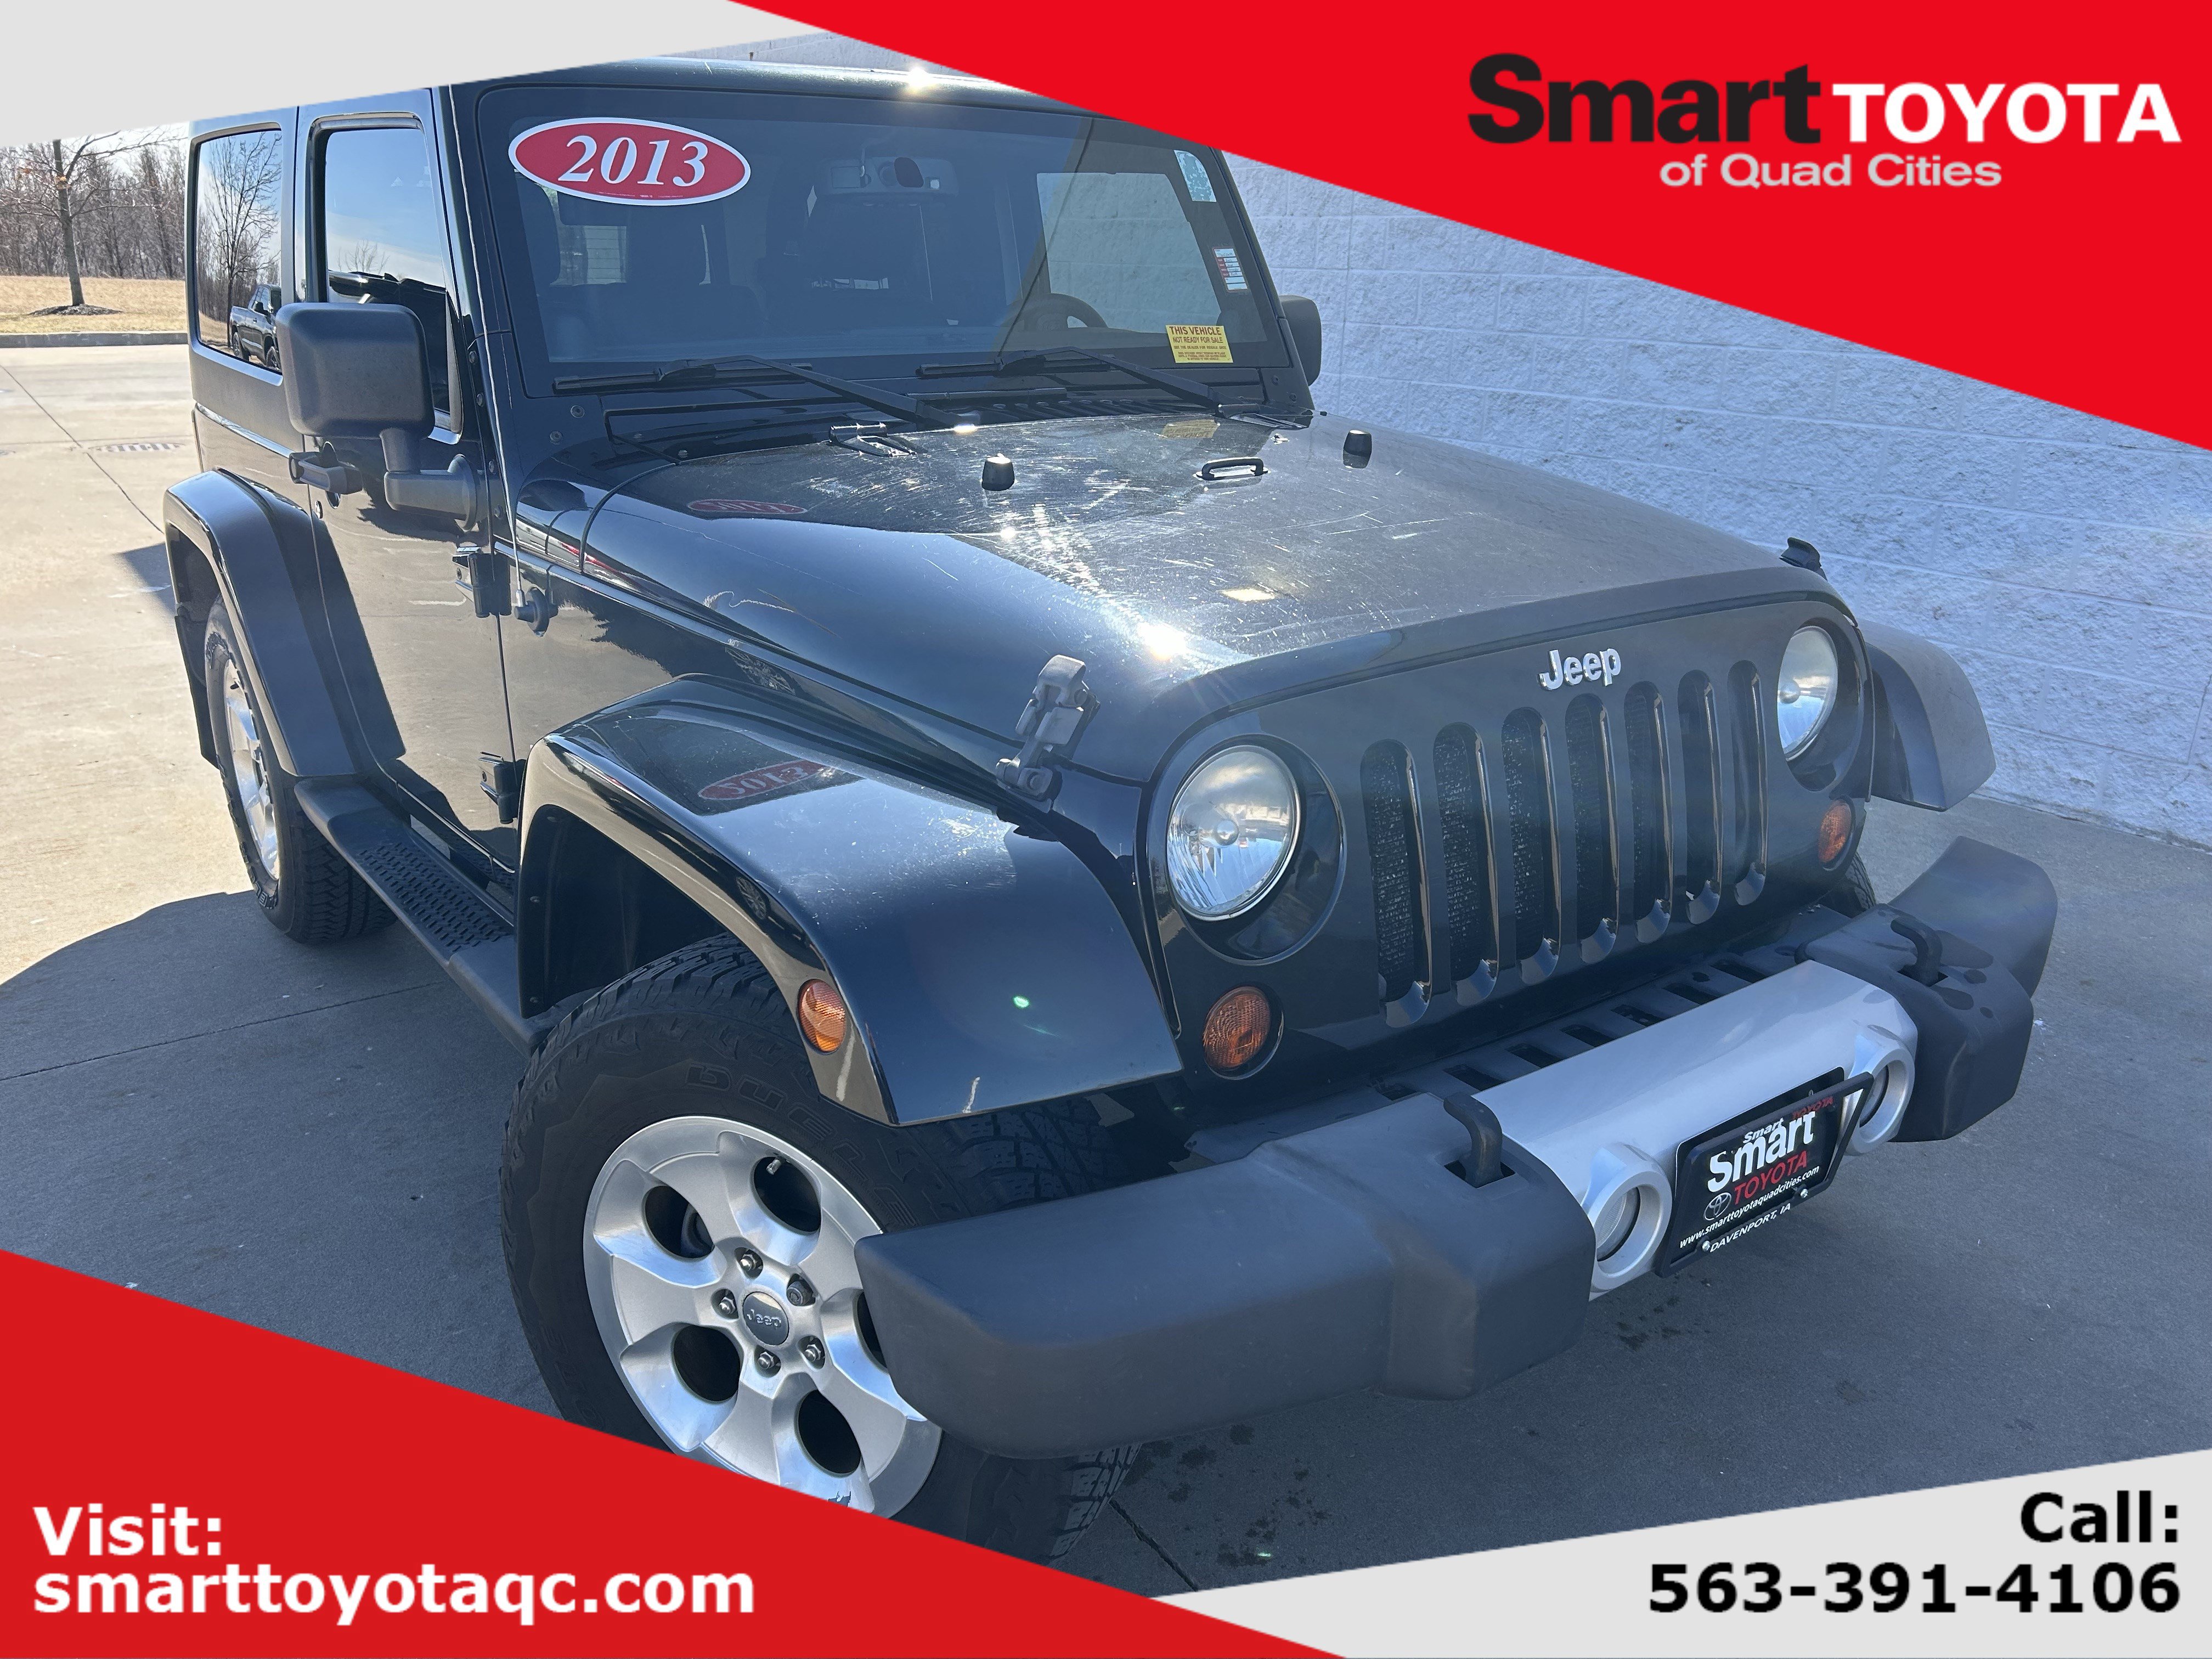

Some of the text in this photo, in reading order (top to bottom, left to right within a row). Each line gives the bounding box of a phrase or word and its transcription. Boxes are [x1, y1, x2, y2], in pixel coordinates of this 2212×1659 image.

[558, 135, 709, 187] 2013
[1169, 326, 1222, 335] THIS VEHICLE
[1539, 648, 1621, 690] Jeep
[685, 1062, 921, 1227] DUELE
[1707, 1111, 1816, 1192] Smart
[1743, 1118, 1784, 1144] Smart
[1734, 1150, 1807, 1204] TOYOTA
[1680, 1165, 1820, 1248] www.smarttoyotaquadcities.com
[1710, 1203, 1791, 1252] DAVENPORT, IA
[747, 1309, 781, 1328] Jeep
